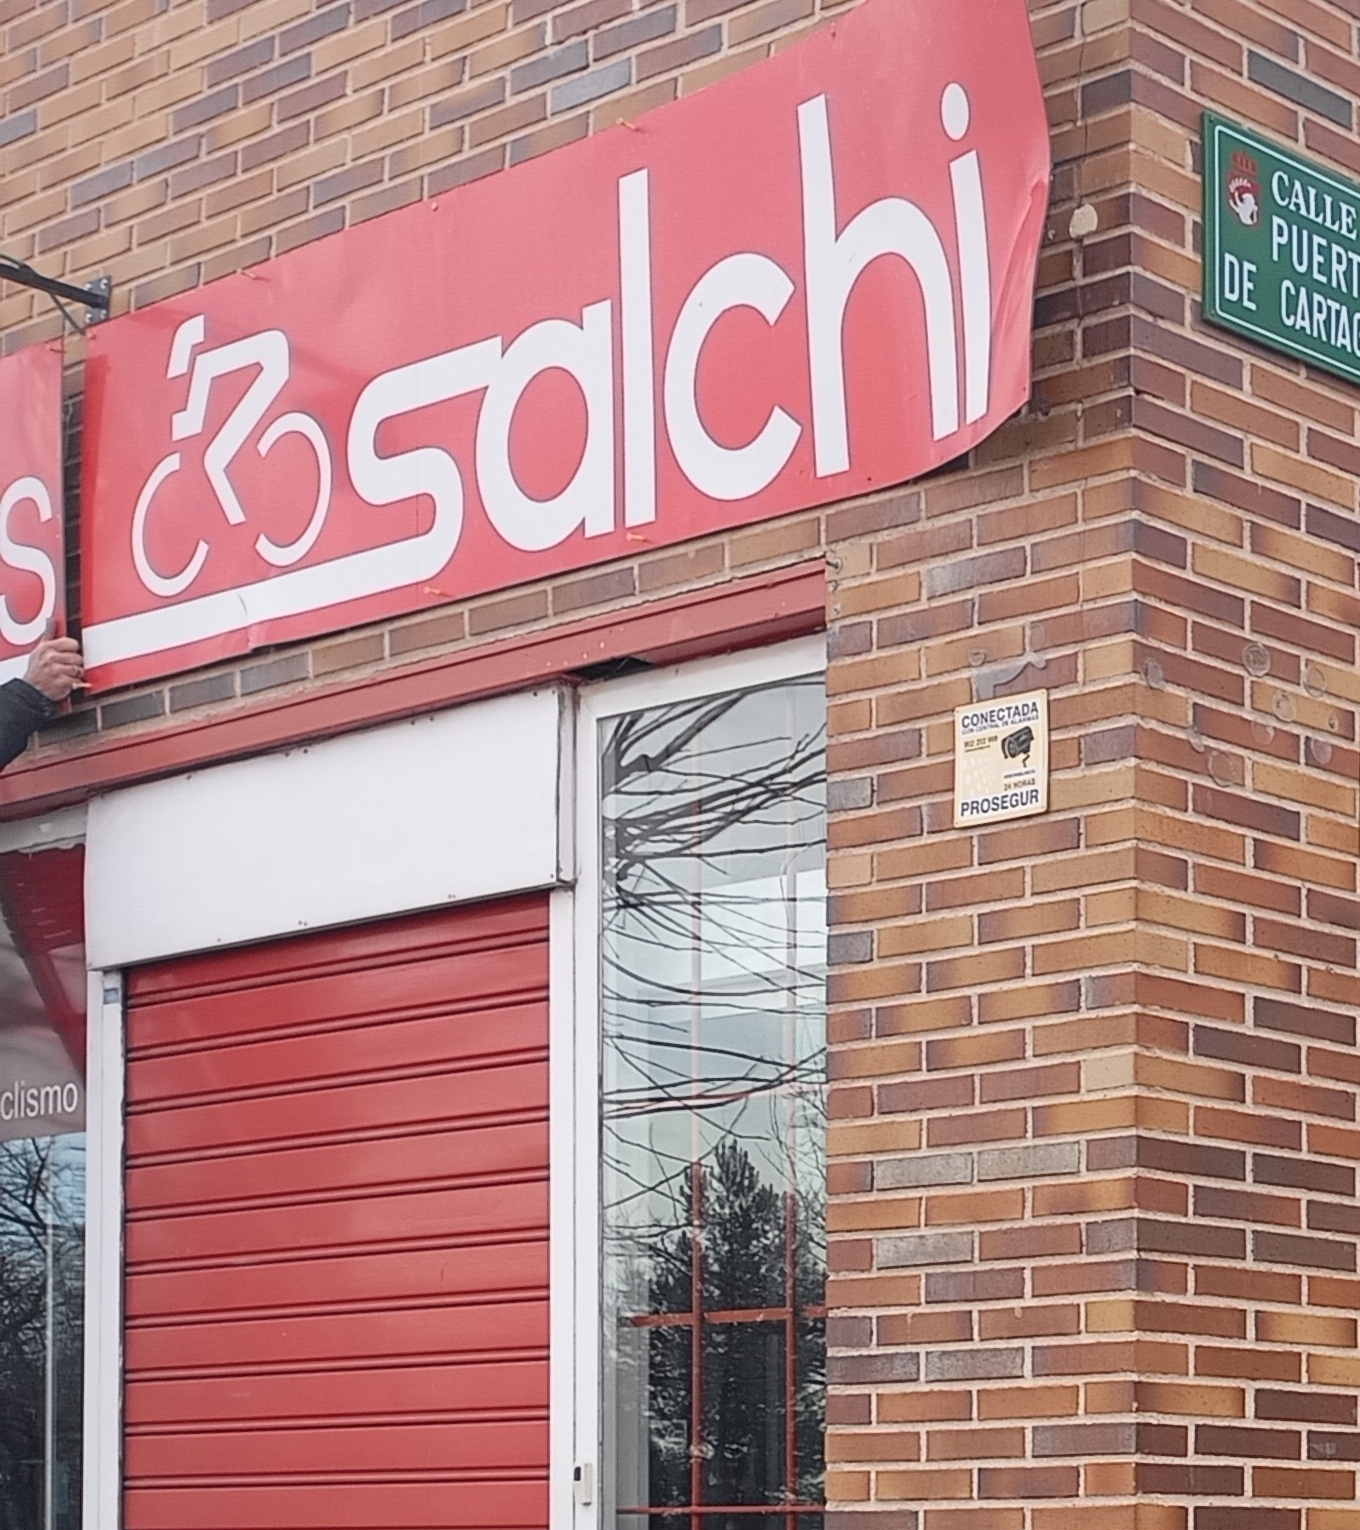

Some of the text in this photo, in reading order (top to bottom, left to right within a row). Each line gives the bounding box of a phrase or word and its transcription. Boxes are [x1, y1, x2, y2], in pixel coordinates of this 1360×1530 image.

[1271, 170, 1358, 240] CALLE
[1224, 252, 1258, 311] DE
[346, 82, 992, 579] salchi
[961, 701, 1039, 729] CONECTADA
[961, 788, 1039, 817] PROSEGUR
